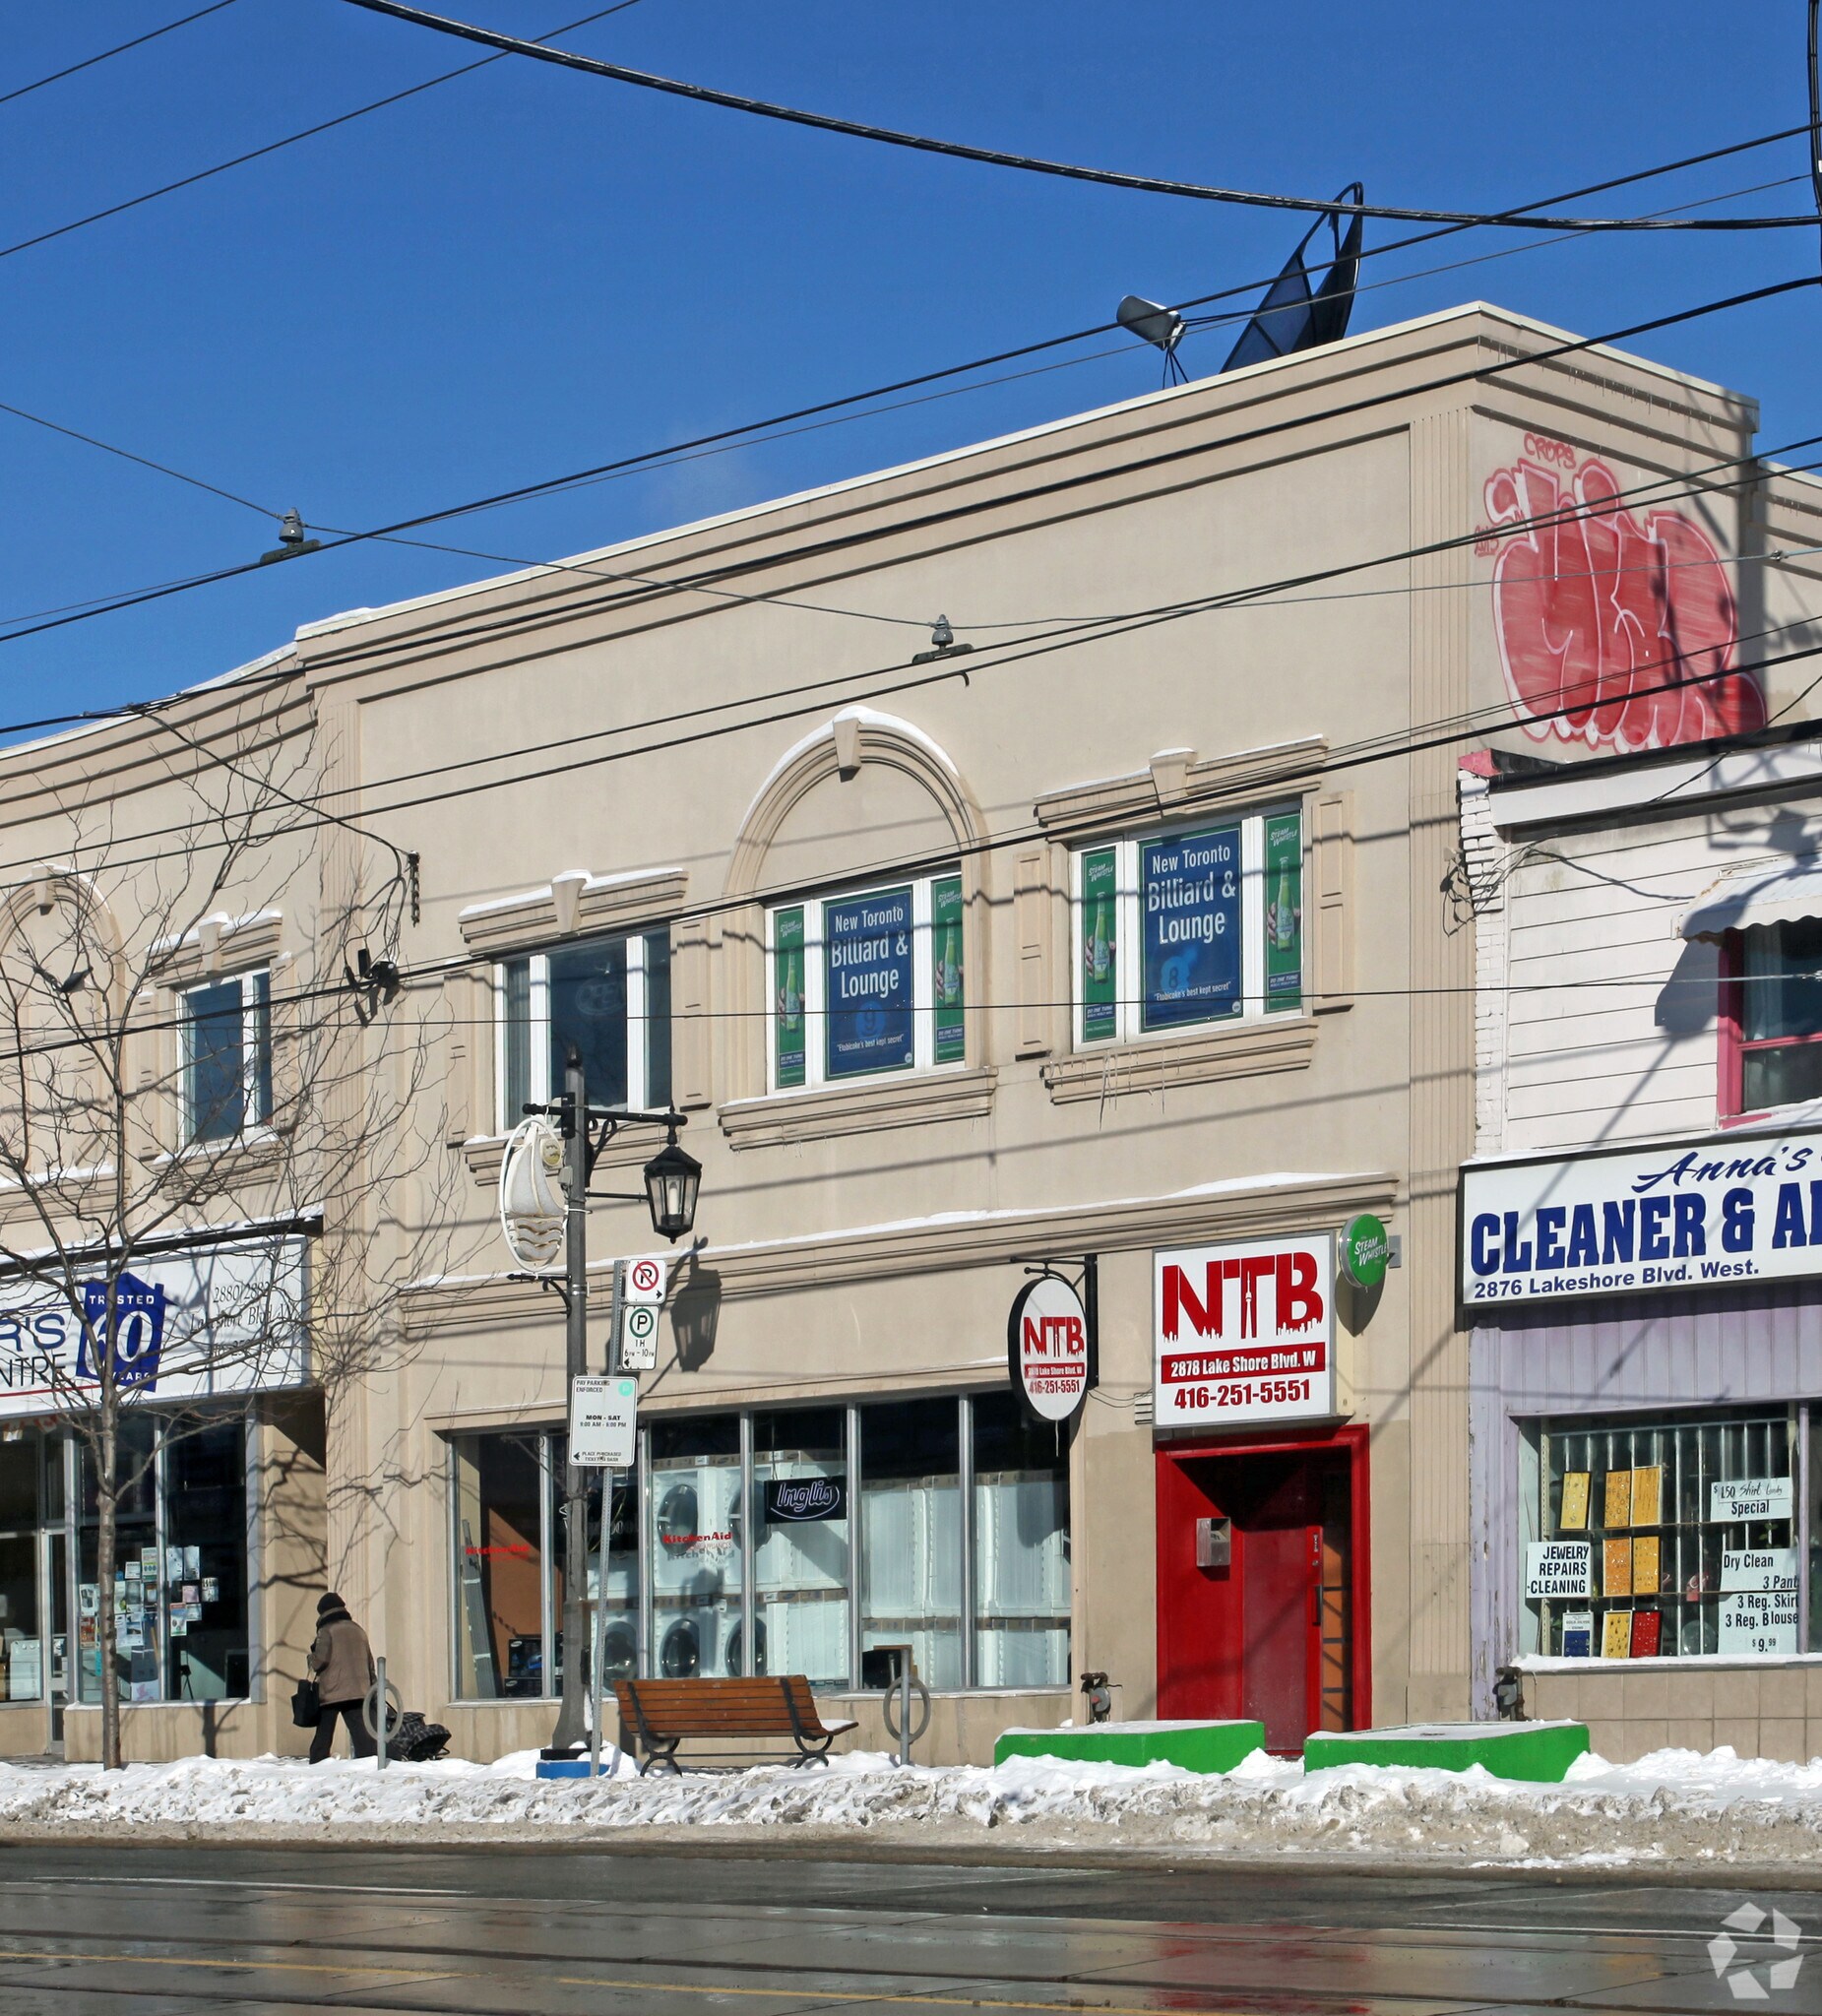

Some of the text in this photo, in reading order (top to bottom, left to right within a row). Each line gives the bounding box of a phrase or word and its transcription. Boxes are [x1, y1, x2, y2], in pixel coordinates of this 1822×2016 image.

[1152, 845, 1230, 874] New Toronto
[1148, 870, 1236, 913] Billiard &
[835, 906, 904, 933] New Toronto
[1159, 912, 1225, 945] Lounge
[831, 930, 908, 968] Billiard &
[841, 968, 900, 999] Lounge
[1630, 1146, 1813, 1193] Anna's
[1353, 1236, 1378, 1255] STEAM
[1470, 1192, 1707, 1277] CLEANER
[1721, 1187, 1755, 1254] &
[1358, 1242, 1387, 1267] WHISTLE
[1474, 1258, 1759, 1298] 2876 Lakeshore Blvd. West.
[89, 1294, 155, 1305] TRSTED
[1162, 1251, 1324, 1343] NTB
[1024, 1317, 1085, 1357] NTB
[1039, 1366, 1050, 1375] Lake
[1050, 1365, 1064, 1375] Shore
[1077, 1365, 1082, 1374] W
[1170, 1350, 1316, 1377] 2878 Lake Shore Blvd. W
[1029, 1380, 1081, 1394] 416-251-5551
[1174, 1378, 1310, 1409] 416-251-5551
[777, 1480, 833, 1513] Inglis
[1730, 1499, 1770, 1517] Special
[662, 1531, 733, 1544] KitchenAid
[1542, 1545, 1589, 1560] JEWELRY
[1724, 1553, 1774, 1571] Dry Clean
[1539, 1562, 1587, 1577] REPAIRS
[1763, 1576, 1770, 1590] 3
[1737, 1596, 1744, 1609] 3
[1747, 1595, 1770, 1611] Reg.
[1726, 1613, 1732, 1628] 3
[1735, 1613, 1758, 1629] Reg.
